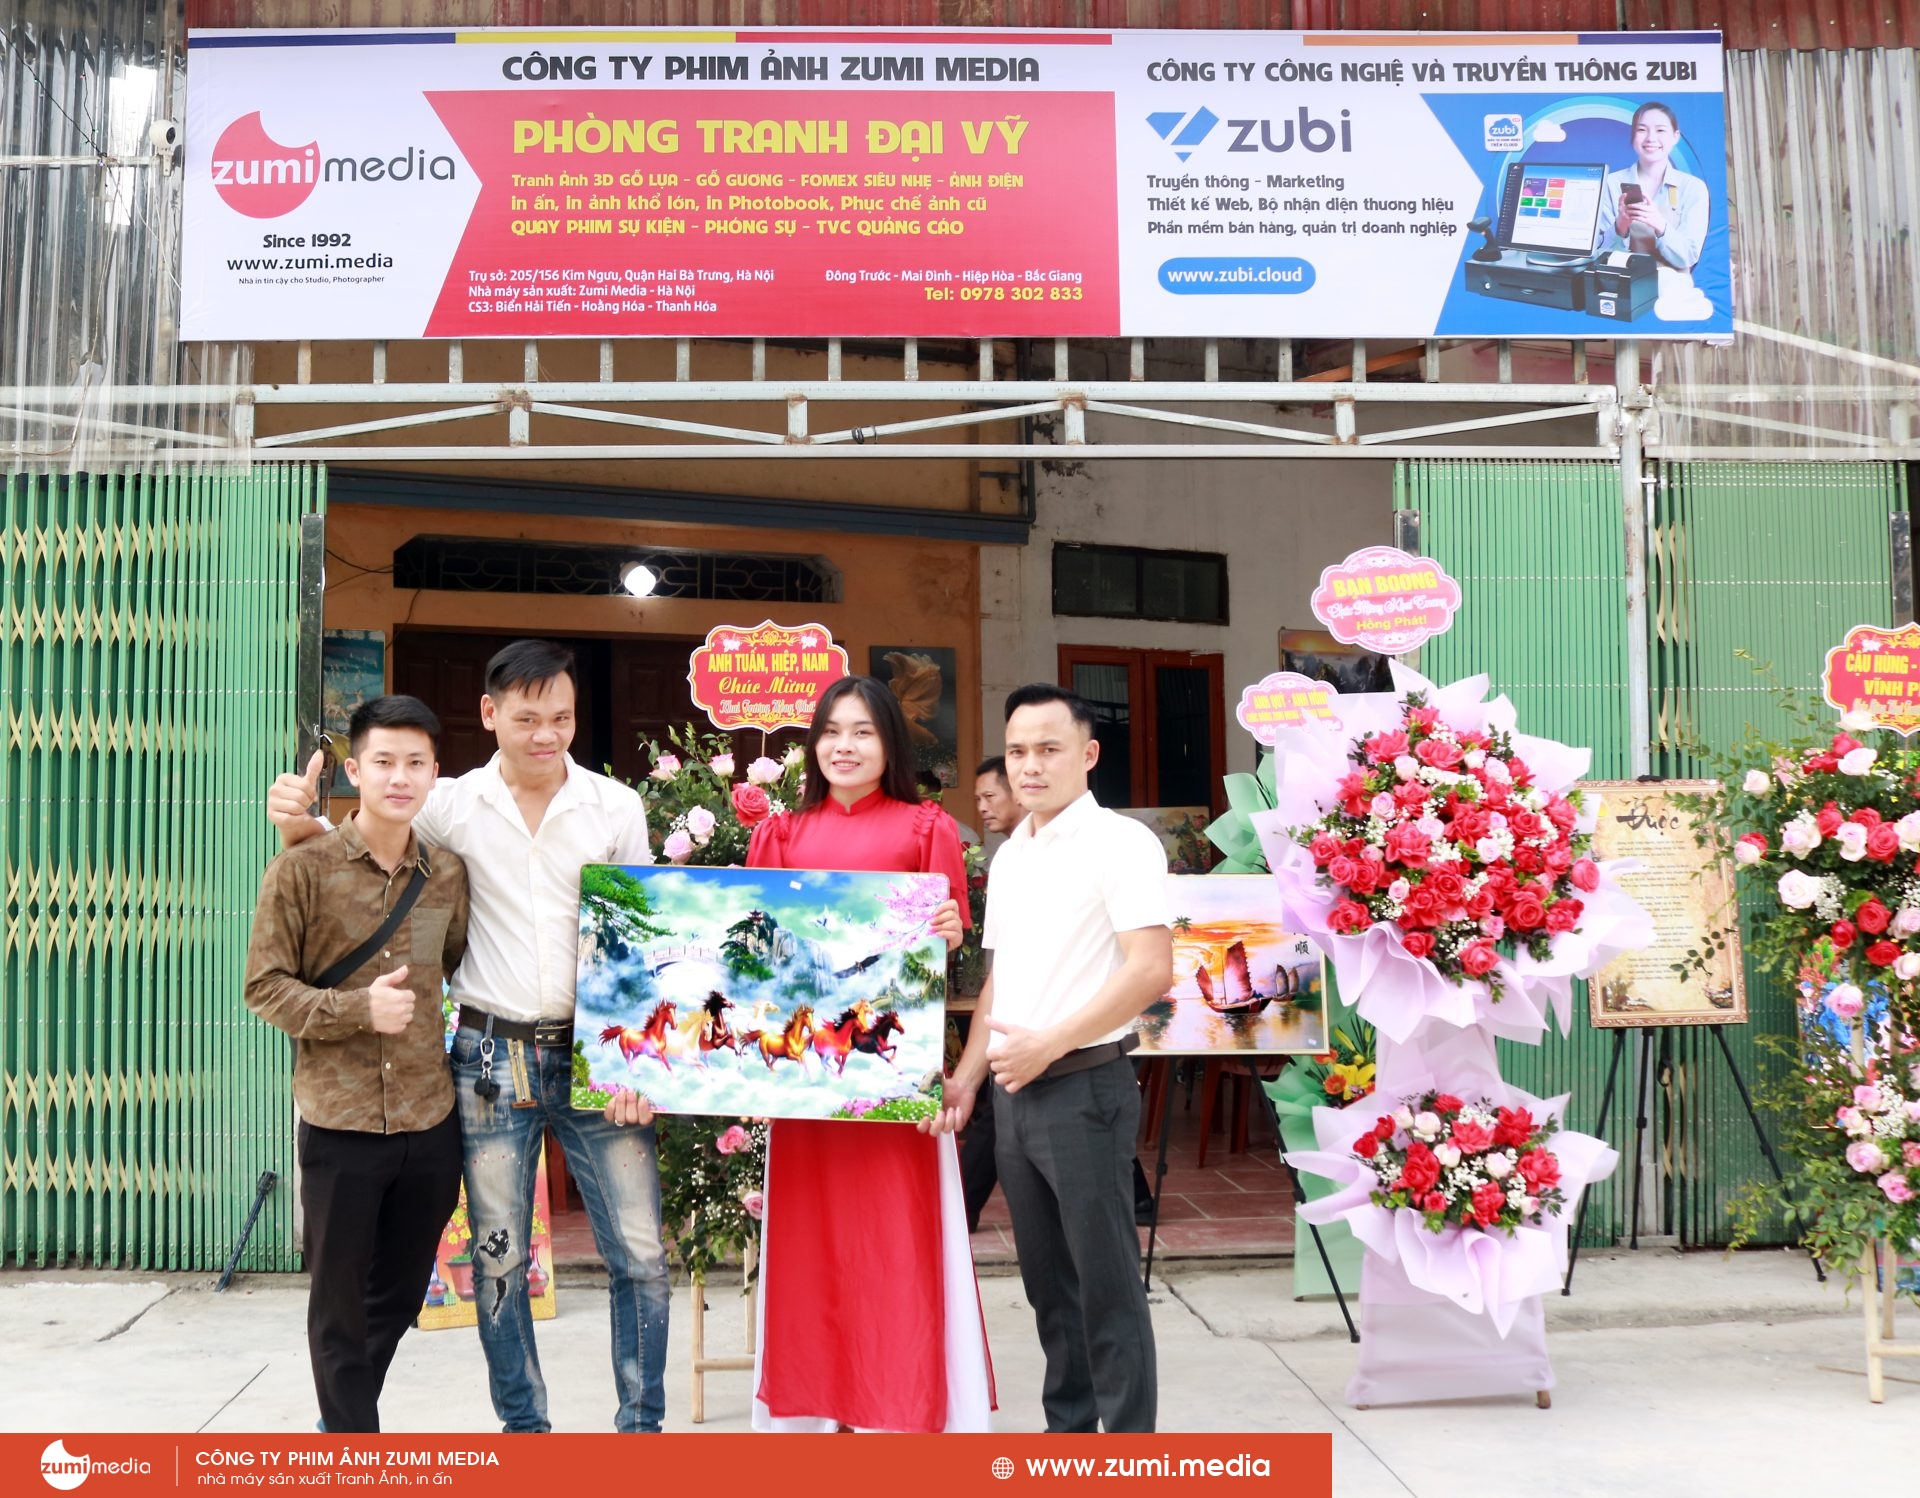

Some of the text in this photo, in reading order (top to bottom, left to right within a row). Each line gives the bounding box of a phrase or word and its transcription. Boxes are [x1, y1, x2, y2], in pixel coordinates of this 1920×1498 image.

[502, 49, 1039, 81] CÔNG TY PHIM ẢNH ZUMI MEDIA
[1147, 55, 1697, 86] CÔNG TY CÔNG NGHỆ VÀ TRUYỀN THÔNG ZUBI
[513, 112, 1029, 163] PHÒNG TRANH ĐẠI VỸ
[1227, 106, 1351, 153] zubi
[1492, 125, 1516, 135] zubi
[213, 146, 455, 185] zumi media
[512, 174, 554, 187] Tranh
[559, 170, 589, 186] Ảnh
[594, 173, 615, 187] 3D
[619, 169, 644, 187] GỖ
[695, 169, 721, 188] GỖ
[725, 173, 784, 187] GƯƠNG
[800, 173, 858, 187] FOMEX
[864, 172, 897, 188] SIÊU
[901, 174, 933, 190] NHẸ
[949, 171, 983, 188] ẢNH
[987, 172, 1024, 190] ĐIỆN
[1205, 175, 1344, 191] thông Marketing
[511, 193, 987, 214] in ấn, in ảnh khổ lớn, in Photobook, Phục chế ảnh cũ
[1147, 196, 1453, 214] Thiết kế Web, Bộ nhận diện hiệu
[511, 216, 965, 237] QUAY PHIM SỰ KIỆN PHÓNG SỰ TVC QUẢNG CÁO
[1229, 222, 1254, 233] bán
[1259, 221, 1296, 236] hàng,
[1362, 222, 1405, 233] doanh
[1410, 221, 1457, 236] nghiệp
[263, 233, 351, 248] Since 1992
[227, 253, 392, 270] www.zumi.media
[238, 275, 385, 285] Nhà in tin cho Studio, Photographer
[469, 270, 487, 283] Trụ
[490, 269, 507, 281] sở:
[510, 269, 559, 283] 205/156
[562, 269, 585, 280] Kim
[625, 269, 655, 282] Quận
[658, 269, 676, 280] Hai
[679, 270, 694, 280] Bà
[697, 270, 733, 283] Trưng,
[736, 270, 752, 280] Hà
[754, 269, 774, 282] Nội
[826, 269, 1082, 284] Đông Trước Mai Đình Hiệp Hòa Bắc Giang
[1168, 267, 1302, 282] www.zubi.cloud
[469, 284, 695, 298] Nhà máy sản xuất: Zumi Media Hà Nội
[924, 287, 1082, 300] Tel: 0978 302 833
[468, 299, 717, 312] CS3: Biển Hải Tiến Hóa Thanh Hóa
[1332, 571, 1438, 599] BẠN BOONG
[708, 647, 829, 676] ANH TUẤN, HIỆP, NAM
[1846, 650, 1909, 676] CẬU HÙNG
[719, 676, 817, 696] Chúc Mừng
[1864, 677, 1904, 696] VĨNH
